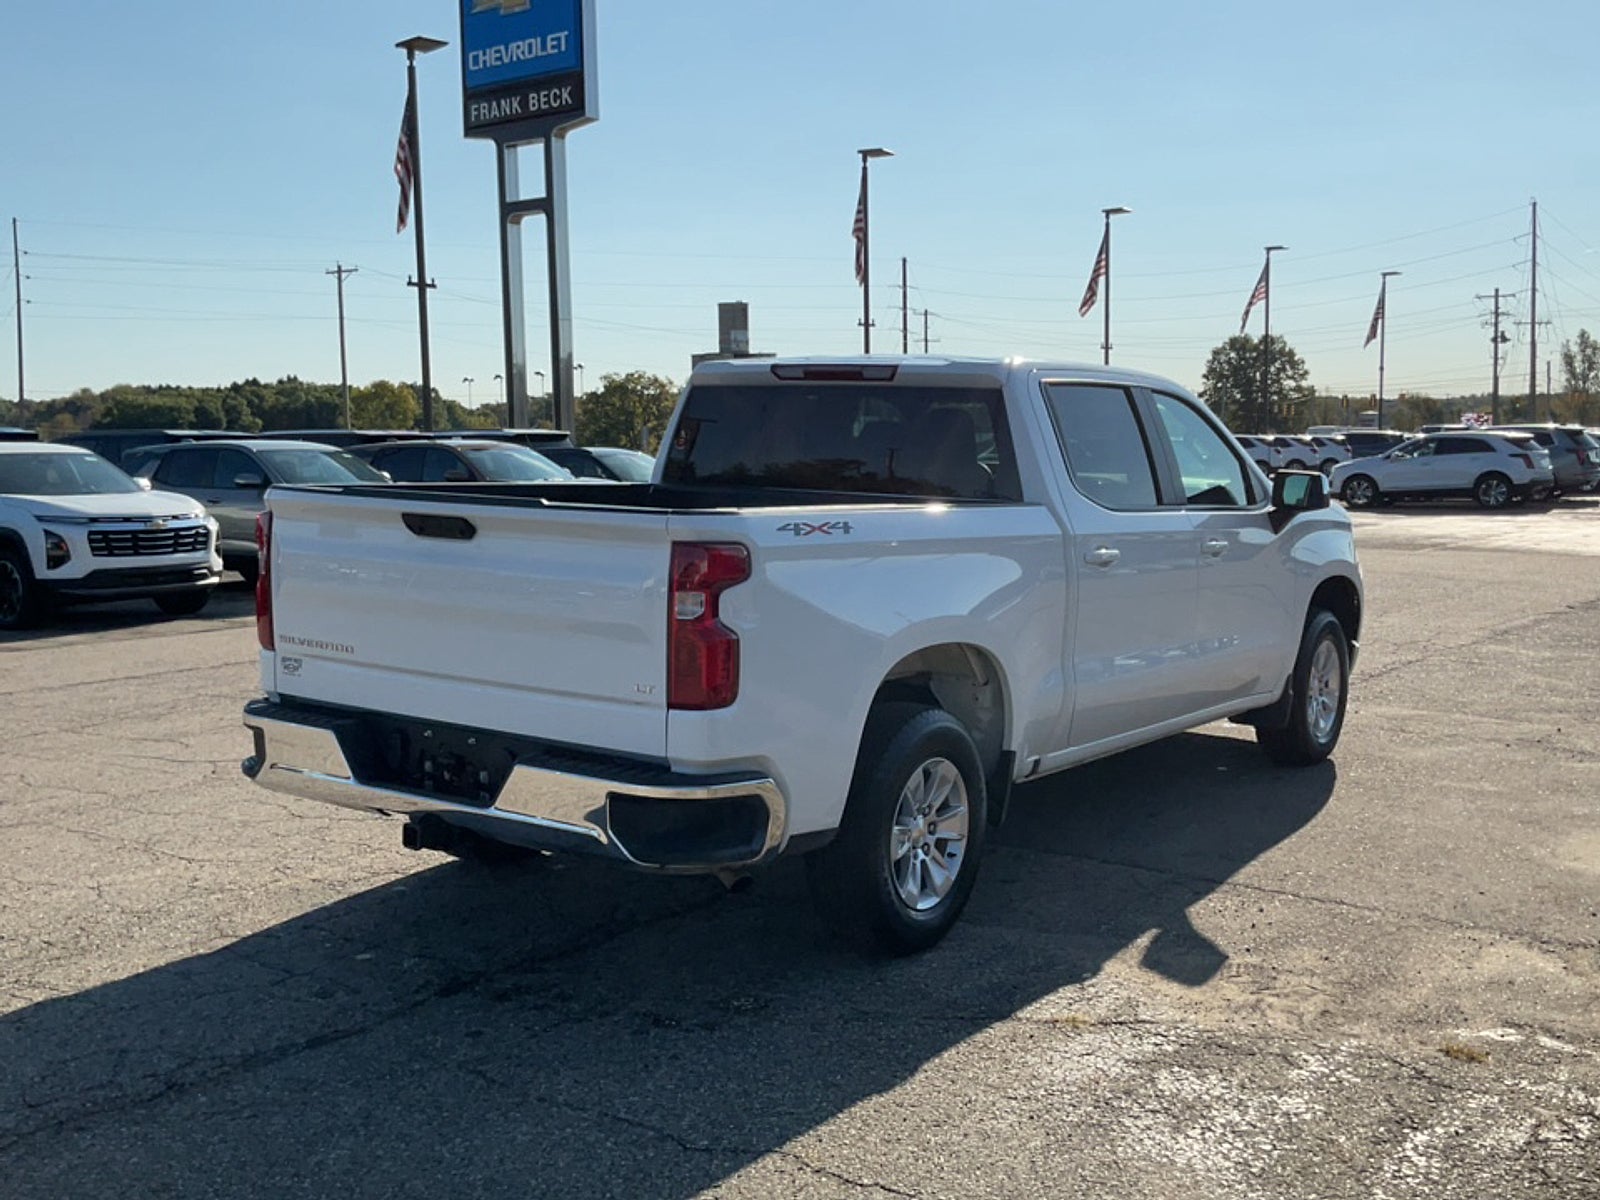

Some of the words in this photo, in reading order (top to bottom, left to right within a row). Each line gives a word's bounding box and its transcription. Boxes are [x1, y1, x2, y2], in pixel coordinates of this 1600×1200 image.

[468, 31, 569, 71] CHEVROLET
[471, 96, 522, 121] FRANK
[528, 86, 573, 111] BECK
[279, 634, 355, 655] SILVERADO
[635, 683, 656, 695] LT
